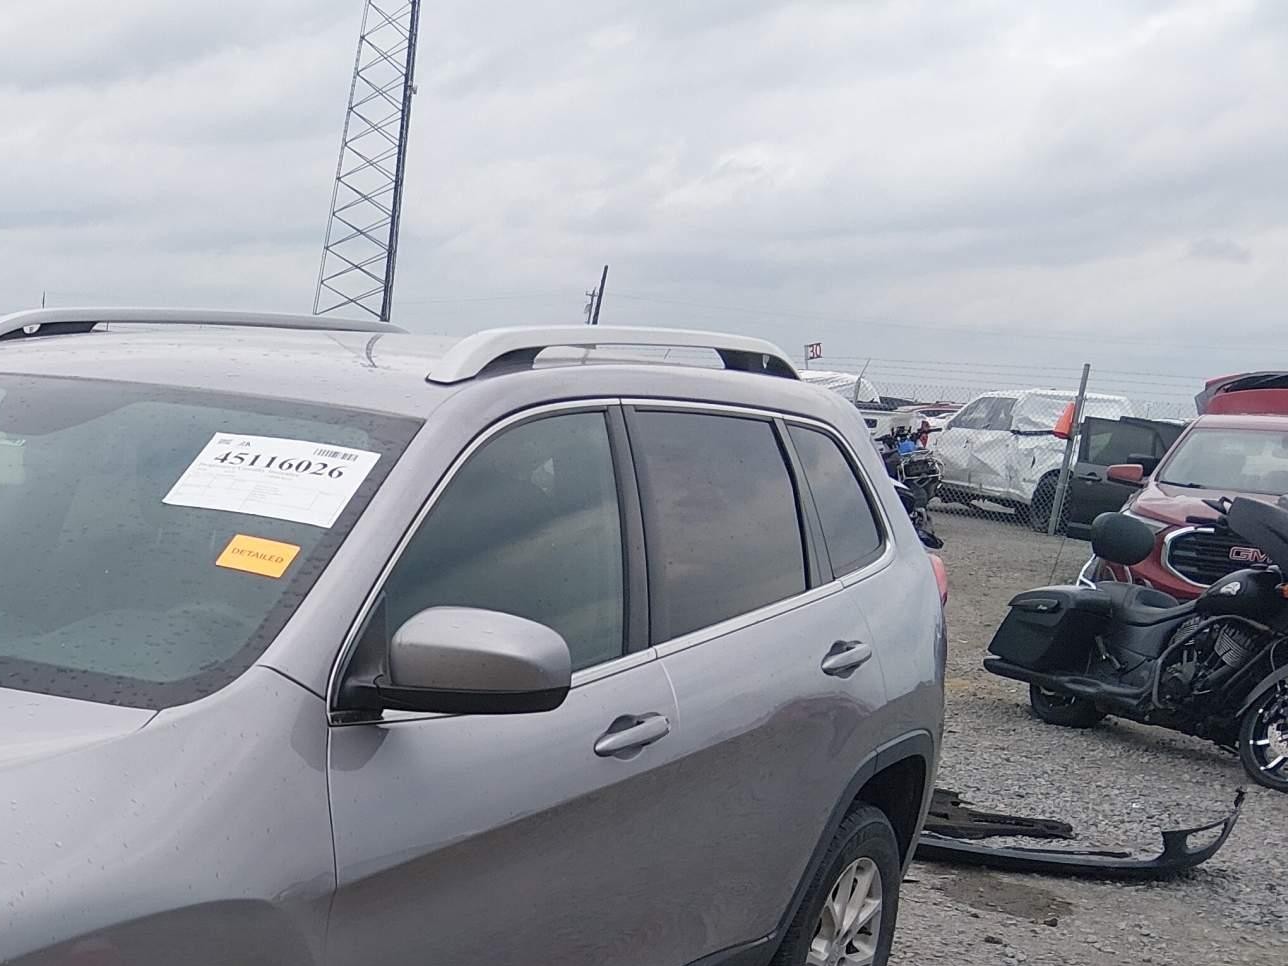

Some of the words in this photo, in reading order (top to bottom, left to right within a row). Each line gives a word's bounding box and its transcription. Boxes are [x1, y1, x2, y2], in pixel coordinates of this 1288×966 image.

[809, 343, 822, 359] 30
[214, 451, 347, 479] 45116026
[231, 547, 284, 563] DETAILED
